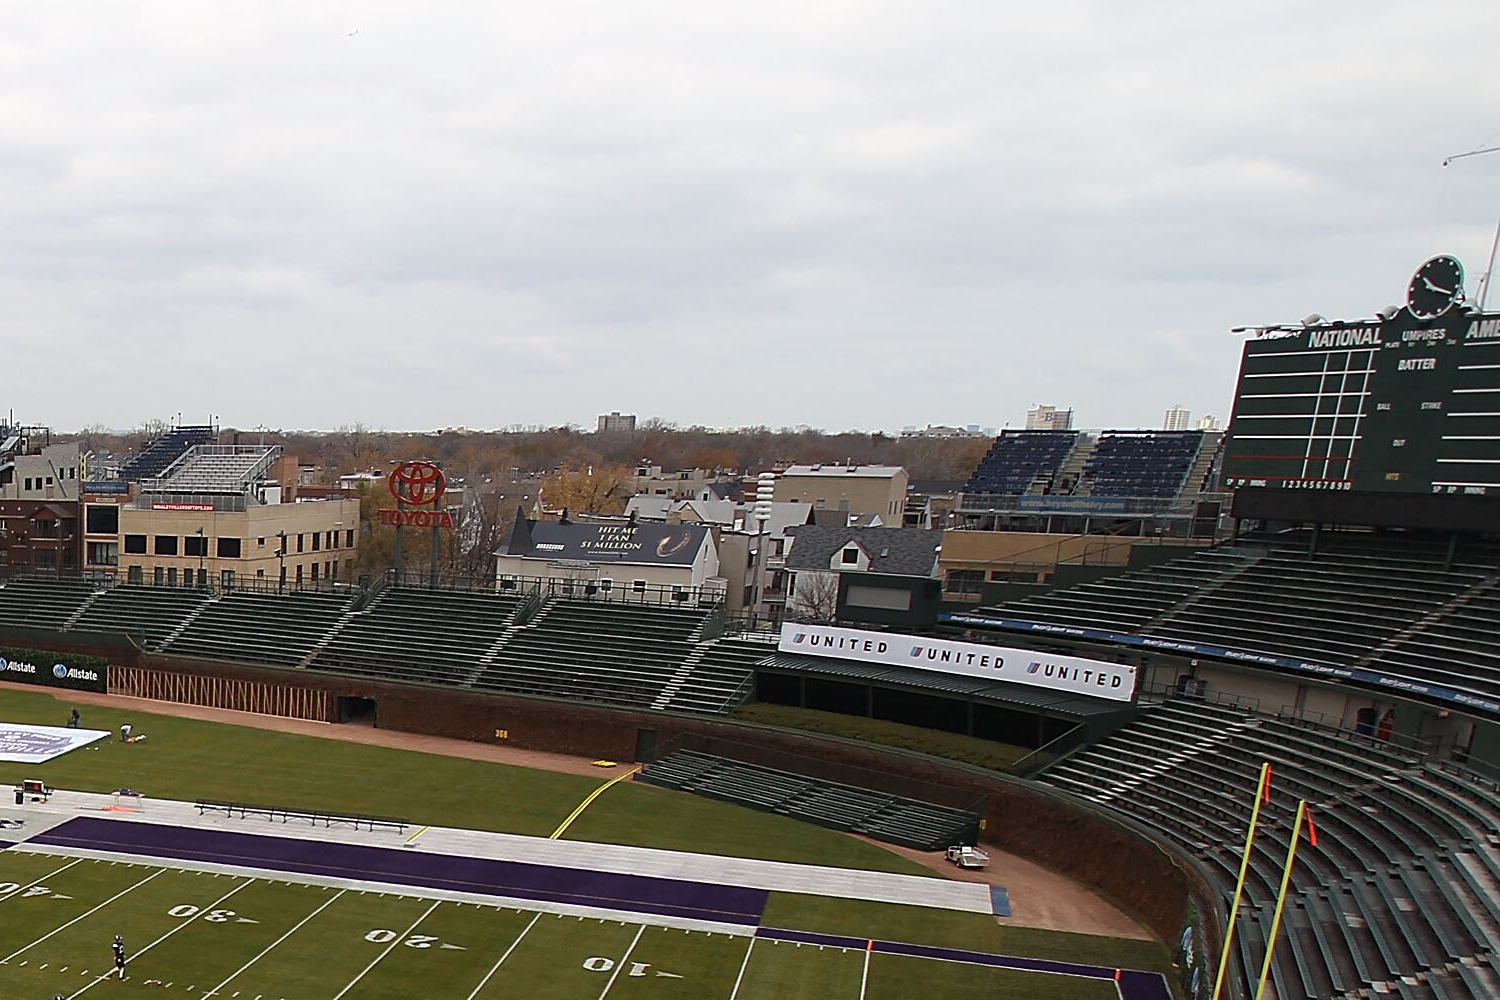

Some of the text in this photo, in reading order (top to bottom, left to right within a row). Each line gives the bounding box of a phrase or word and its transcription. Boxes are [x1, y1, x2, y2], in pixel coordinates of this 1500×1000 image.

[1308, 327, 1382, 348] NATIONAL
[1402, 328, 1447, 341] UMPIRES
[1397, 358, 1436, 371] BATTER
[1420, 402, 1442, 410] STRIKE
[1282, 480, 1287, 488] 1
[1288, 480, 1294, 488] 2
[1294, 480, 1301, 488] 3
[1301, 481, 1308, 489] 4
[1308, 481, 1315, 489] 5
[1315, 481, 1321, 489] 6
[1322, 481, 1328, 489] 7
[1329, 481, 1336, 490] 8
[1336, 481, 1342, 490] 9
[1343, 482, 1352, 490] 10
[378, 508, 454, 528] TOYOTA
[593, 541, 642, 550] MILLION
[607, 534, 630, 542] FAN
[810, 635, 888, 654] UNITED
[927, 648, 1005, 669] UNITED
[6, 661, 36, 673] Allstate
[66, 667, 98, 681] Allstate
[1044, 665, 1122, 688] UNITED
[167, 904, 236, 923] 30
[364, 929, 439, 949] 20
[582, 956, 651, 977] 10
